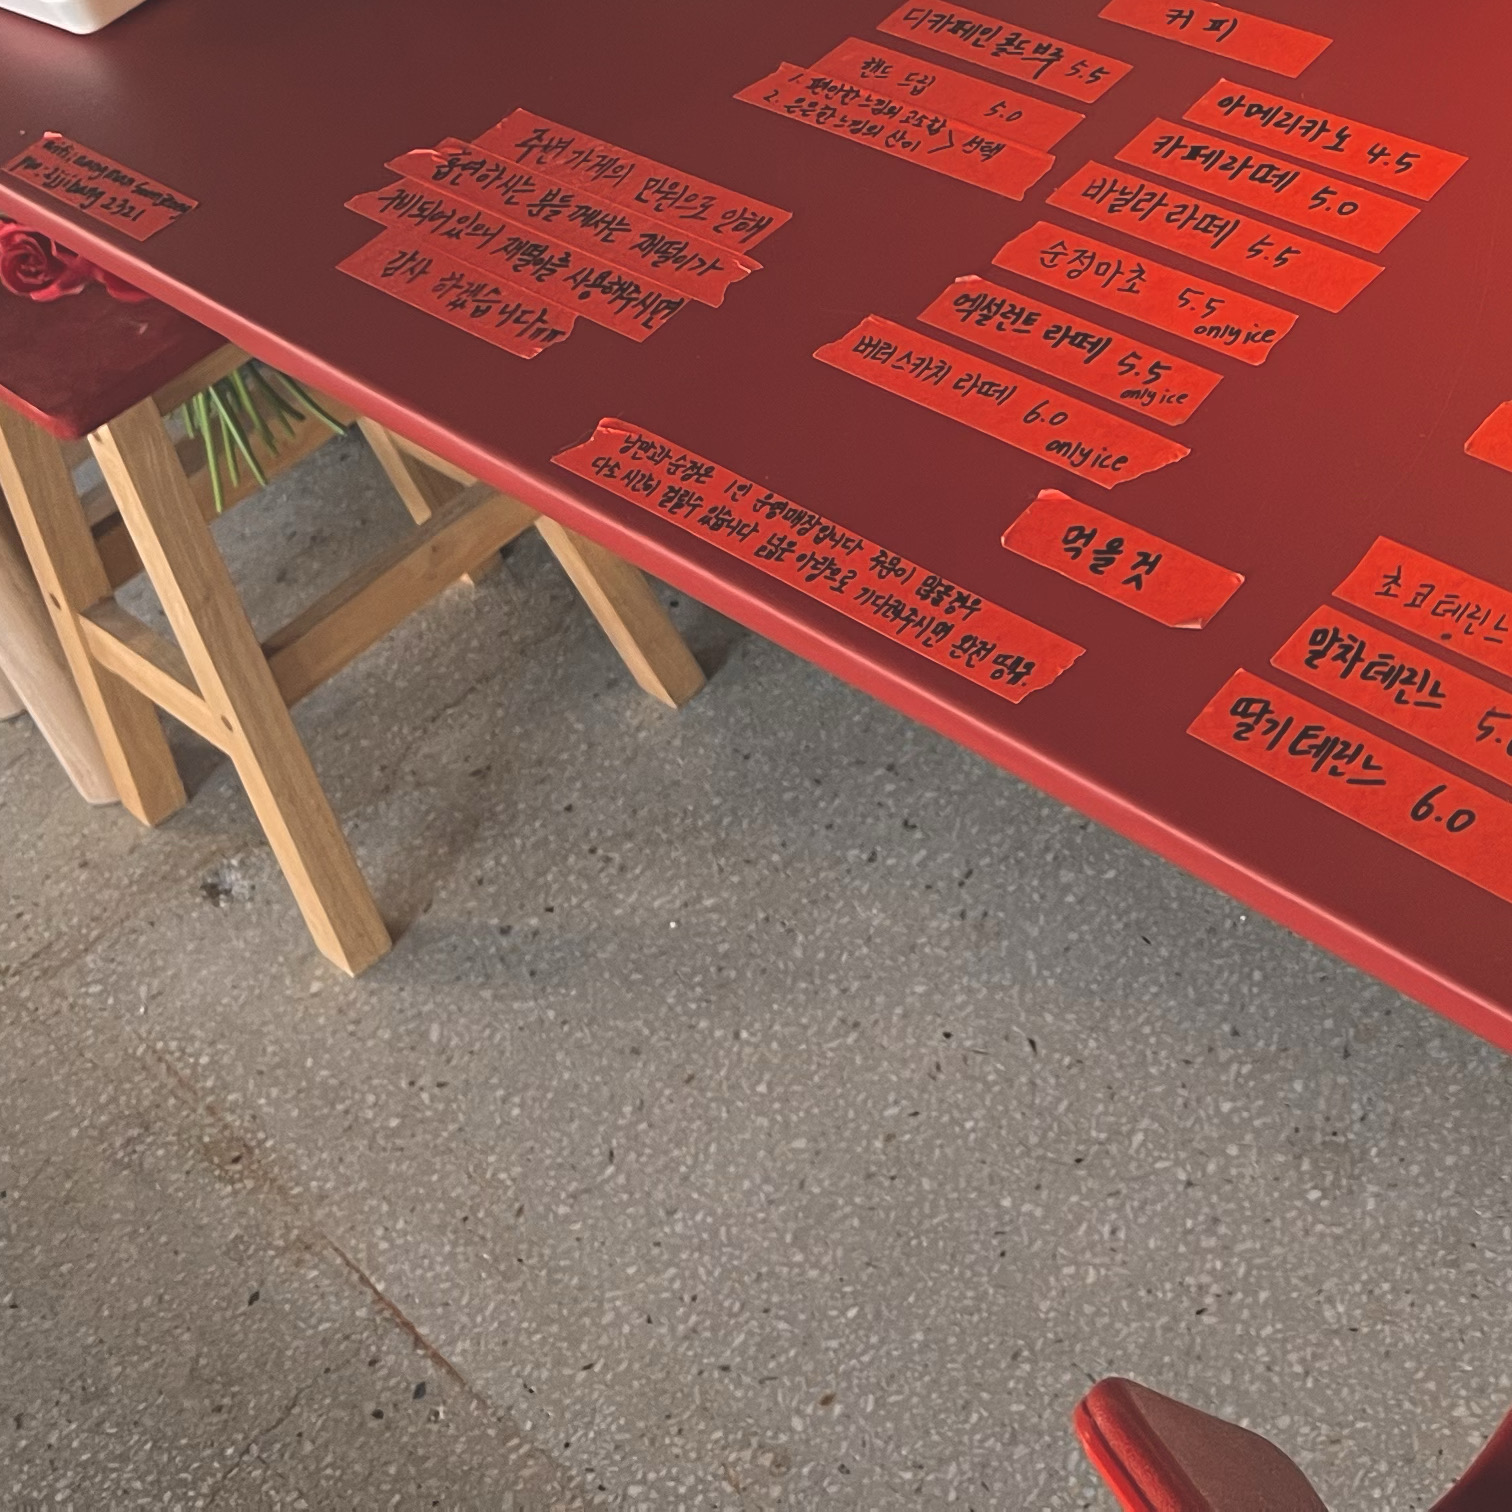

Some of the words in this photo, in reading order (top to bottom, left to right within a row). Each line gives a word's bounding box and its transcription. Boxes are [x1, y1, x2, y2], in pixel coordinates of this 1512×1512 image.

[1064, 60, 1111, 84] 5.5
[984, 101, 1023, 123] 5.0
[1217, 93, 1352, 154] 아메리카노
[1366, 142, 1422, 174] 4.5
[514, 128, 576, 165] 주변
[565, 148, 635, 187] 가게의
[712, 207, 774, 243] 인해
[1153, 133, 1301, 194] 카페라떼
[1307, 185, 1359, 216] 5.0
[1246, 234, 1302, 269] 5.5
[1038, 239, 1148, 295] 순정마초
[1177, 287, 1226, 319] 5.5
[1042, 324, 1113, 365] 라떼
[1117, 351, 1172, 385] 5.5
[1193, 324, 1243, 346] only
[1242, 323, 1278, 345] ice
[952, 372, 1018, 406] 라떼
[1022, 399, 1069, 426] 6.0
[1119, 388, 1157, 407] only
[1158, 388, 1189, 405] ice
[1045, 439, 1094, 468] only
[1090, 447, 1129, 472] ice
[1409, 784, 1477, 833] 6.0
